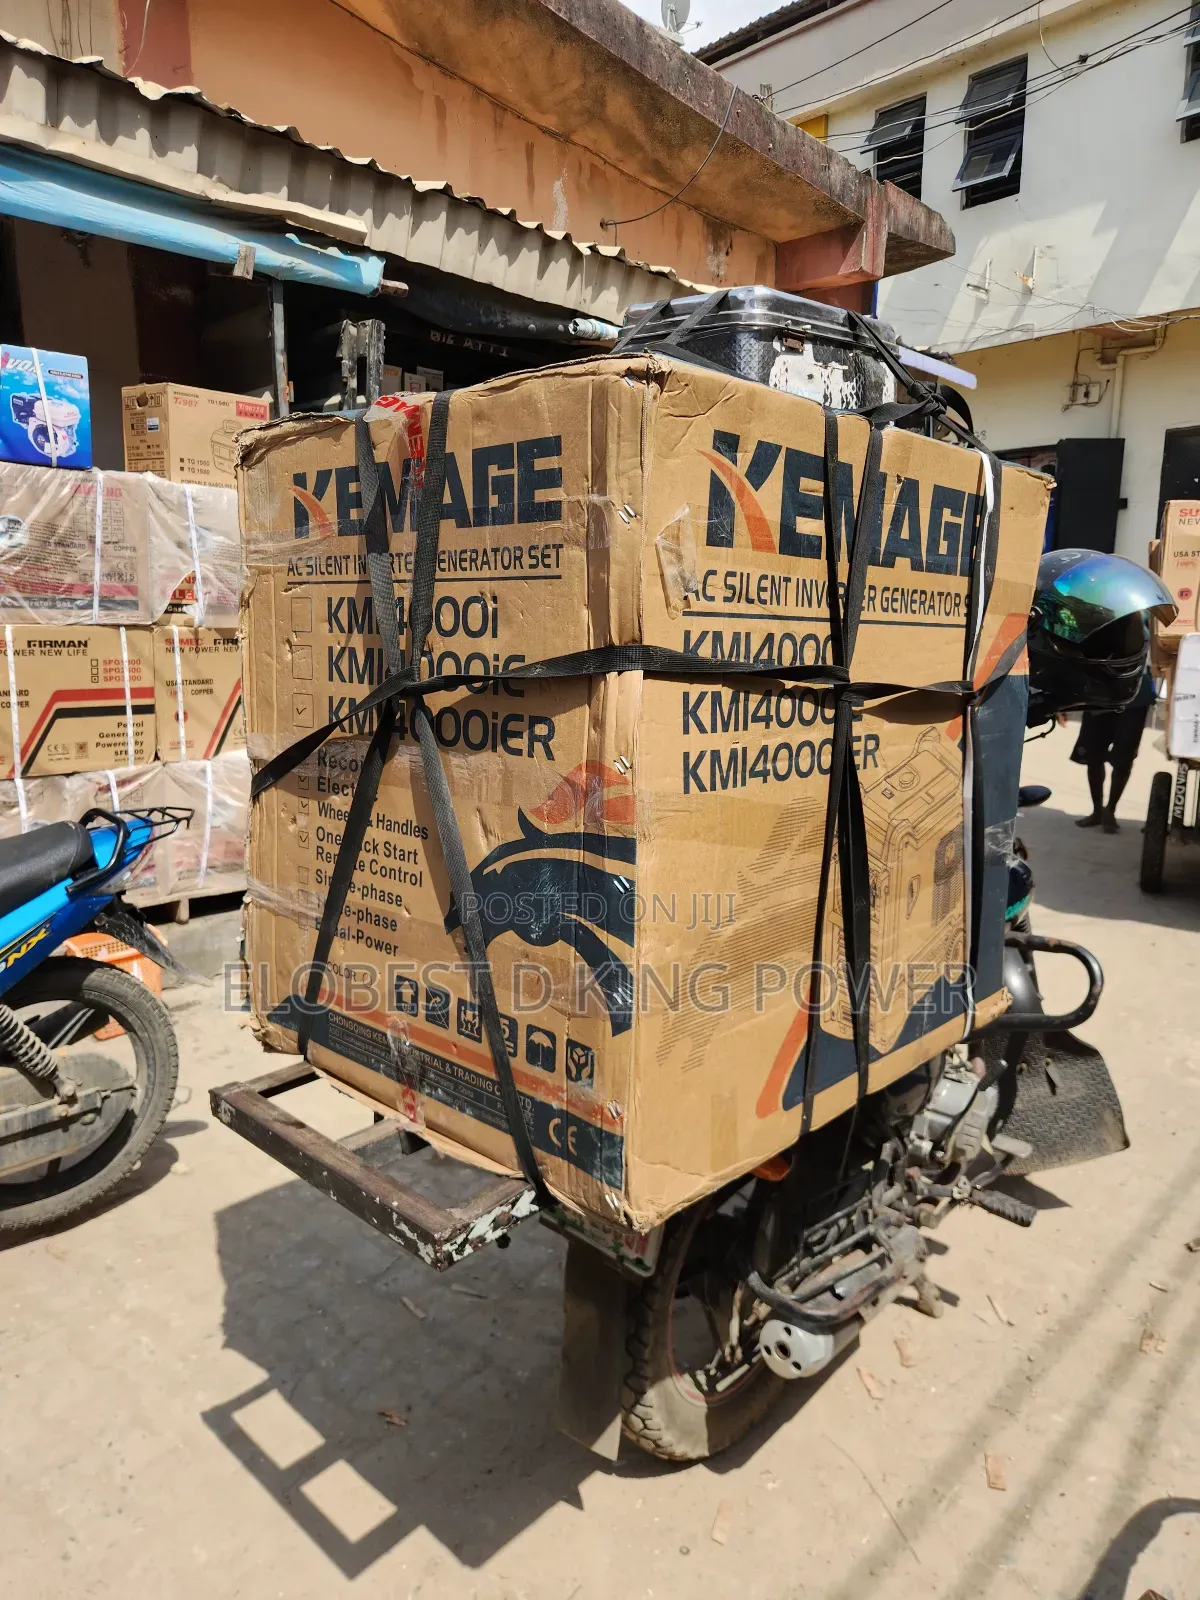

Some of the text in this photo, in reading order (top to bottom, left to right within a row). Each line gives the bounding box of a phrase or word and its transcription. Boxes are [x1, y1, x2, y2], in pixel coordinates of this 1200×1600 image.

[288, 435, 562, 540] KEMAGE
[287, 557, 303, 576] AC
[306, 554, 351, 576] SILENT
[436, 545, 524, 573] ENERATOR
[528, 543, 563, 569] SET
[723, 570, 791, 607] SILENT
[880, 586, 961, 618] GENERATOR
[327, 596, 498, 638] KM400i
[27, 640, 89, 648] FIRMAN
[191, 688, 214, 696] COPPER
[683, 687, 865, 736] KMI4000E
[95, 741, 131, 749] Powere
[317, 747, 366, 773] Recoi
[683, 733, 881, 795] KMI4000ER
[317, 775, 357, 797] Elect
[317, 801, 429, 840] Whee Handles
[383, 841, 418, 865] Start
[369, 858, 423, 888] Control
[327, 961, 357, 982] COLOR
[328, 1012, 372, 1039] CHONGQING
[445, 1063, 452, 1074] &
[453, 1065, 493, 1094] TRADING
[548, 1117, 578, 1157] CE
